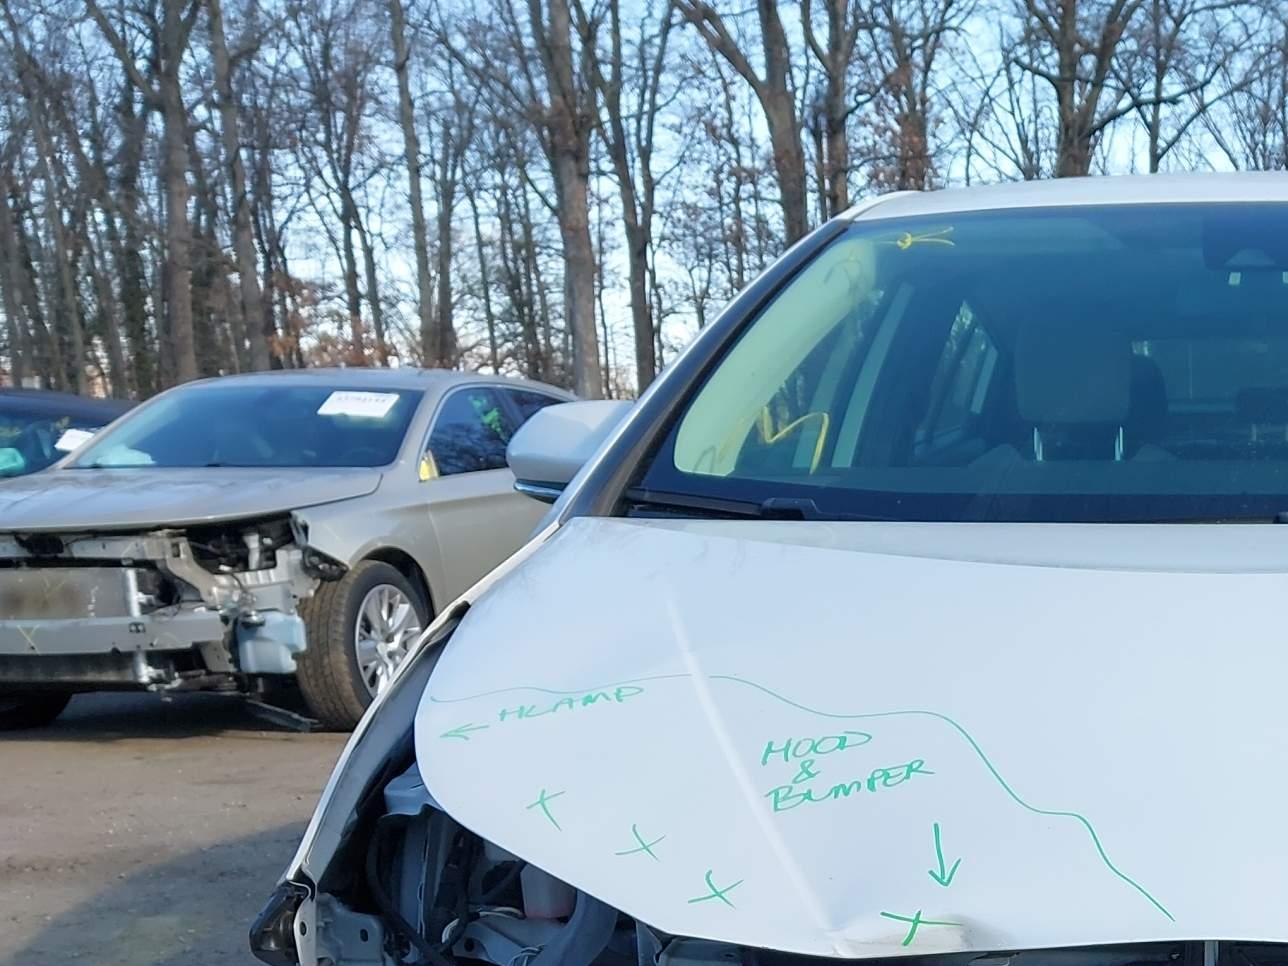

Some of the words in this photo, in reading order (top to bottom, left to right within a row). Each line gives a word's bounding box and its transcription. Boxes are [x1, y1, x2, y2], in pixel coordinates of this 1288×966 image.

[498, 686, 644, 721] HLAMP
[761, 731, 873, 766] HOOD
[764, 759, 936, 812] BUMPER
[792, 759, 822, 784] &
